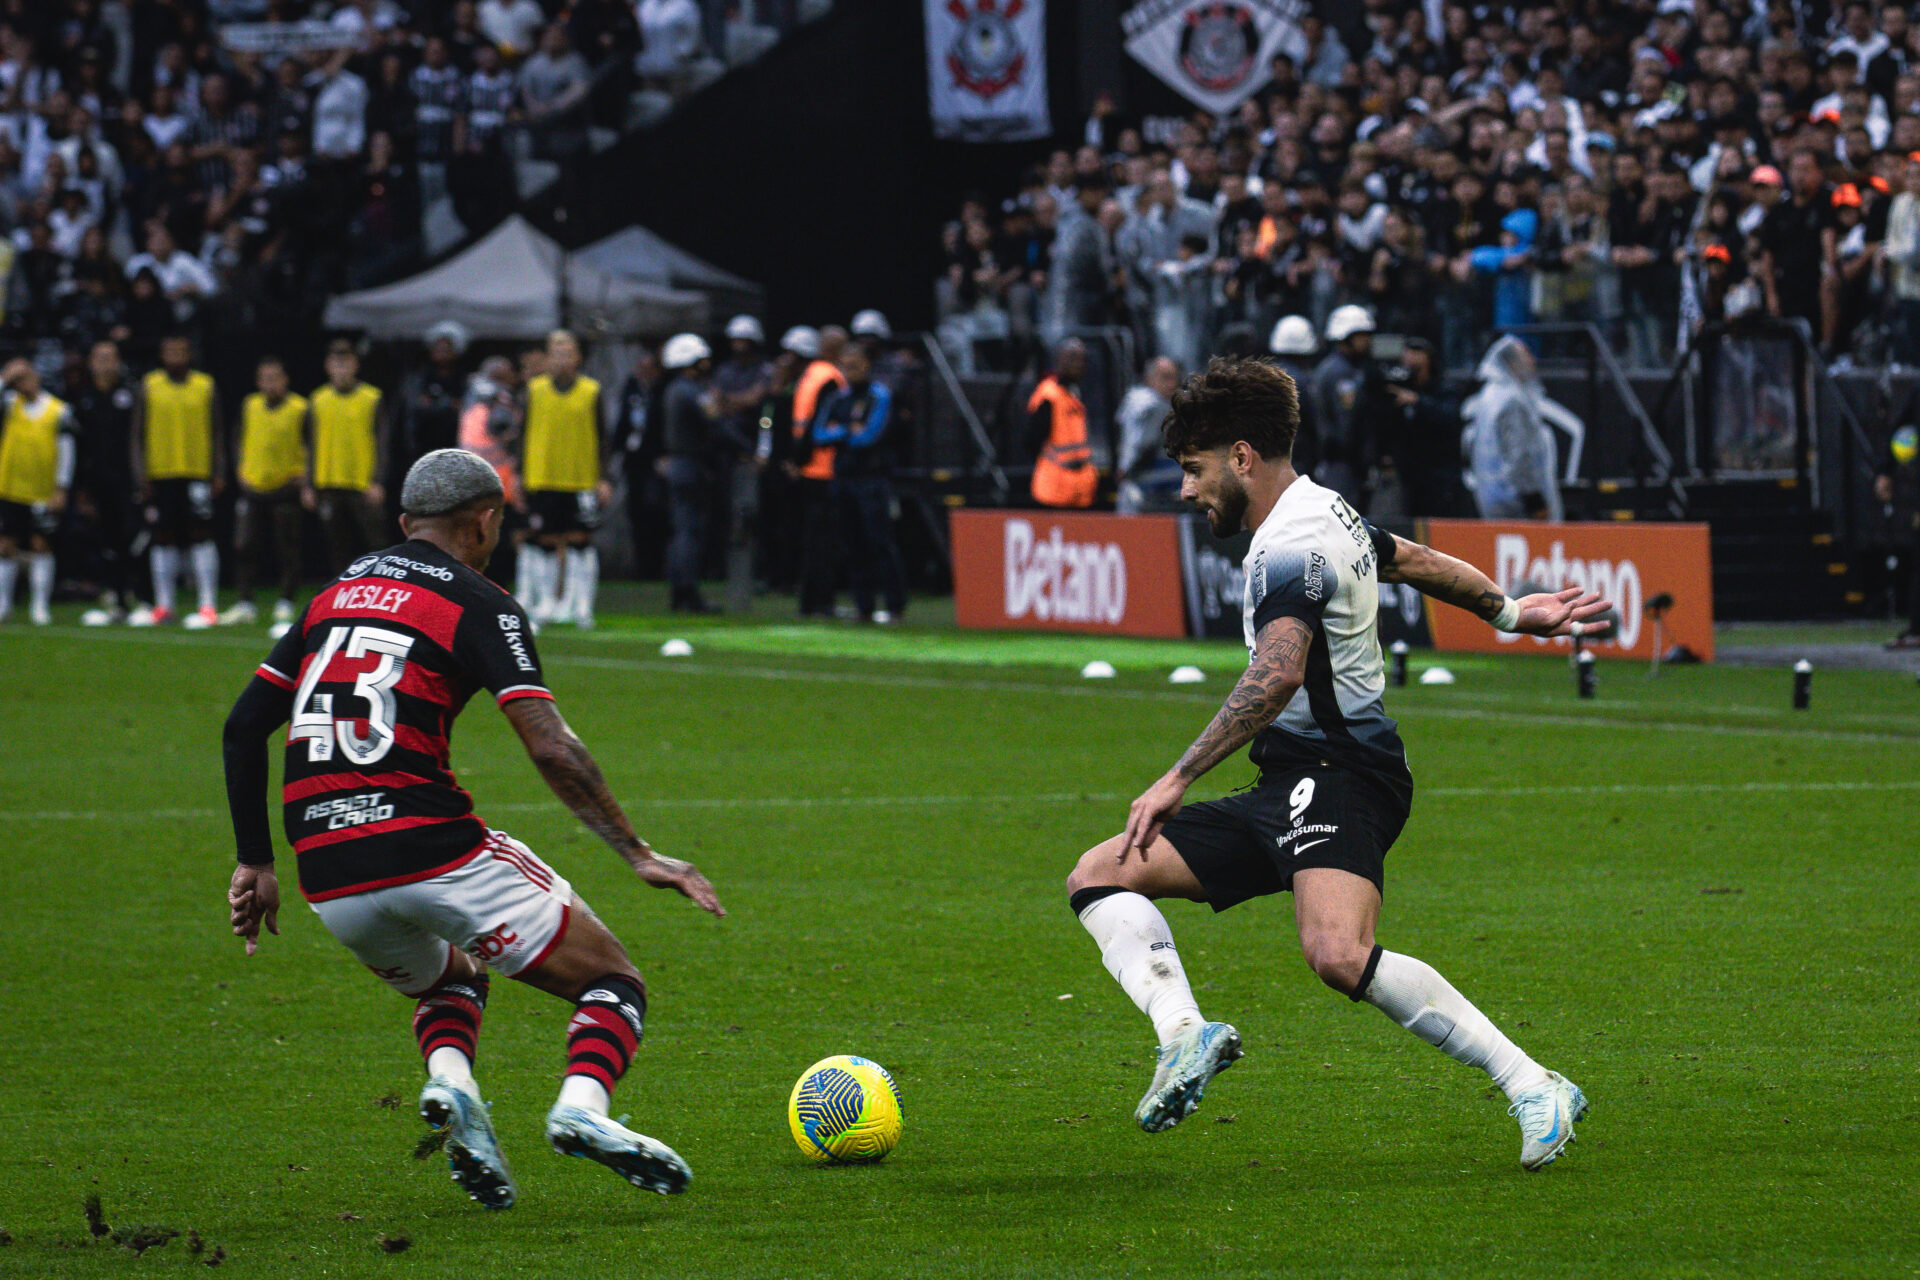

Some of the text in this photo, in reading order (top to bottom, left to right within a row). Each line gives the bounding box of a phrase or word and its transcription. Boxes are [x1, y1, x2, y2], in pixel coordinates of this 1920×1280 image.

[372, 562, 408, 579] livre
[381, 555, 454, 582] mercado
[1004, 518, 1128, 626] Betano
[332, 585, 413, 613] WESLEY
[289, 626, 416, 765] 43
[303, 792, 387, 821] ASSIST
[1289, 777, 1316, 821] 9
[328, 804, 395, 830] CARD
